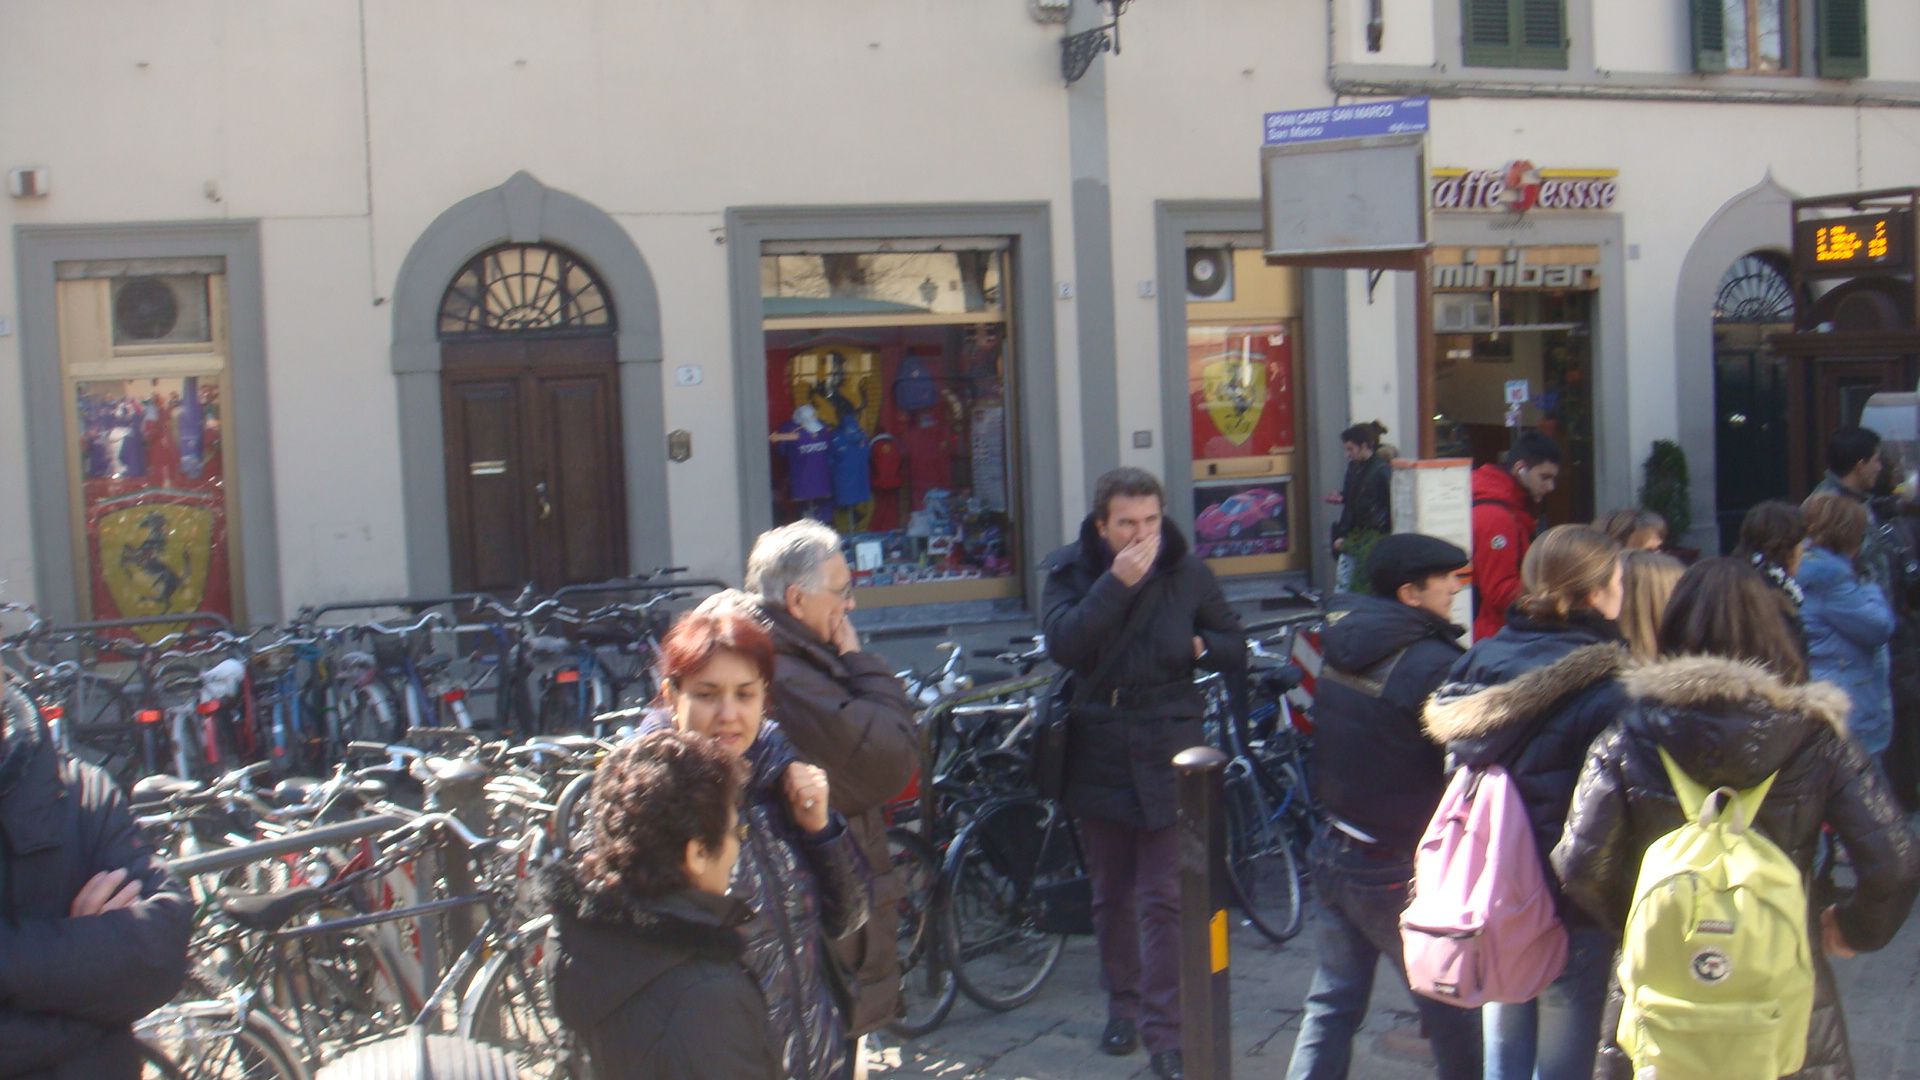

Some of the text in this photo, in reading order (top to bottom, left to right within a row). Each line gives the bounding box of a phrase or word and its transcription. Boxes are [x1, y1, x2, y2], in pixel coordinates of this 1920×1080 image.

[1331, 108, 1354, 122] SAN
[1354, 104, 1394, 119] MARCO
[1268, 126, 1324, 141] San Marco
[1432, 249, 1601, 289] minibar
